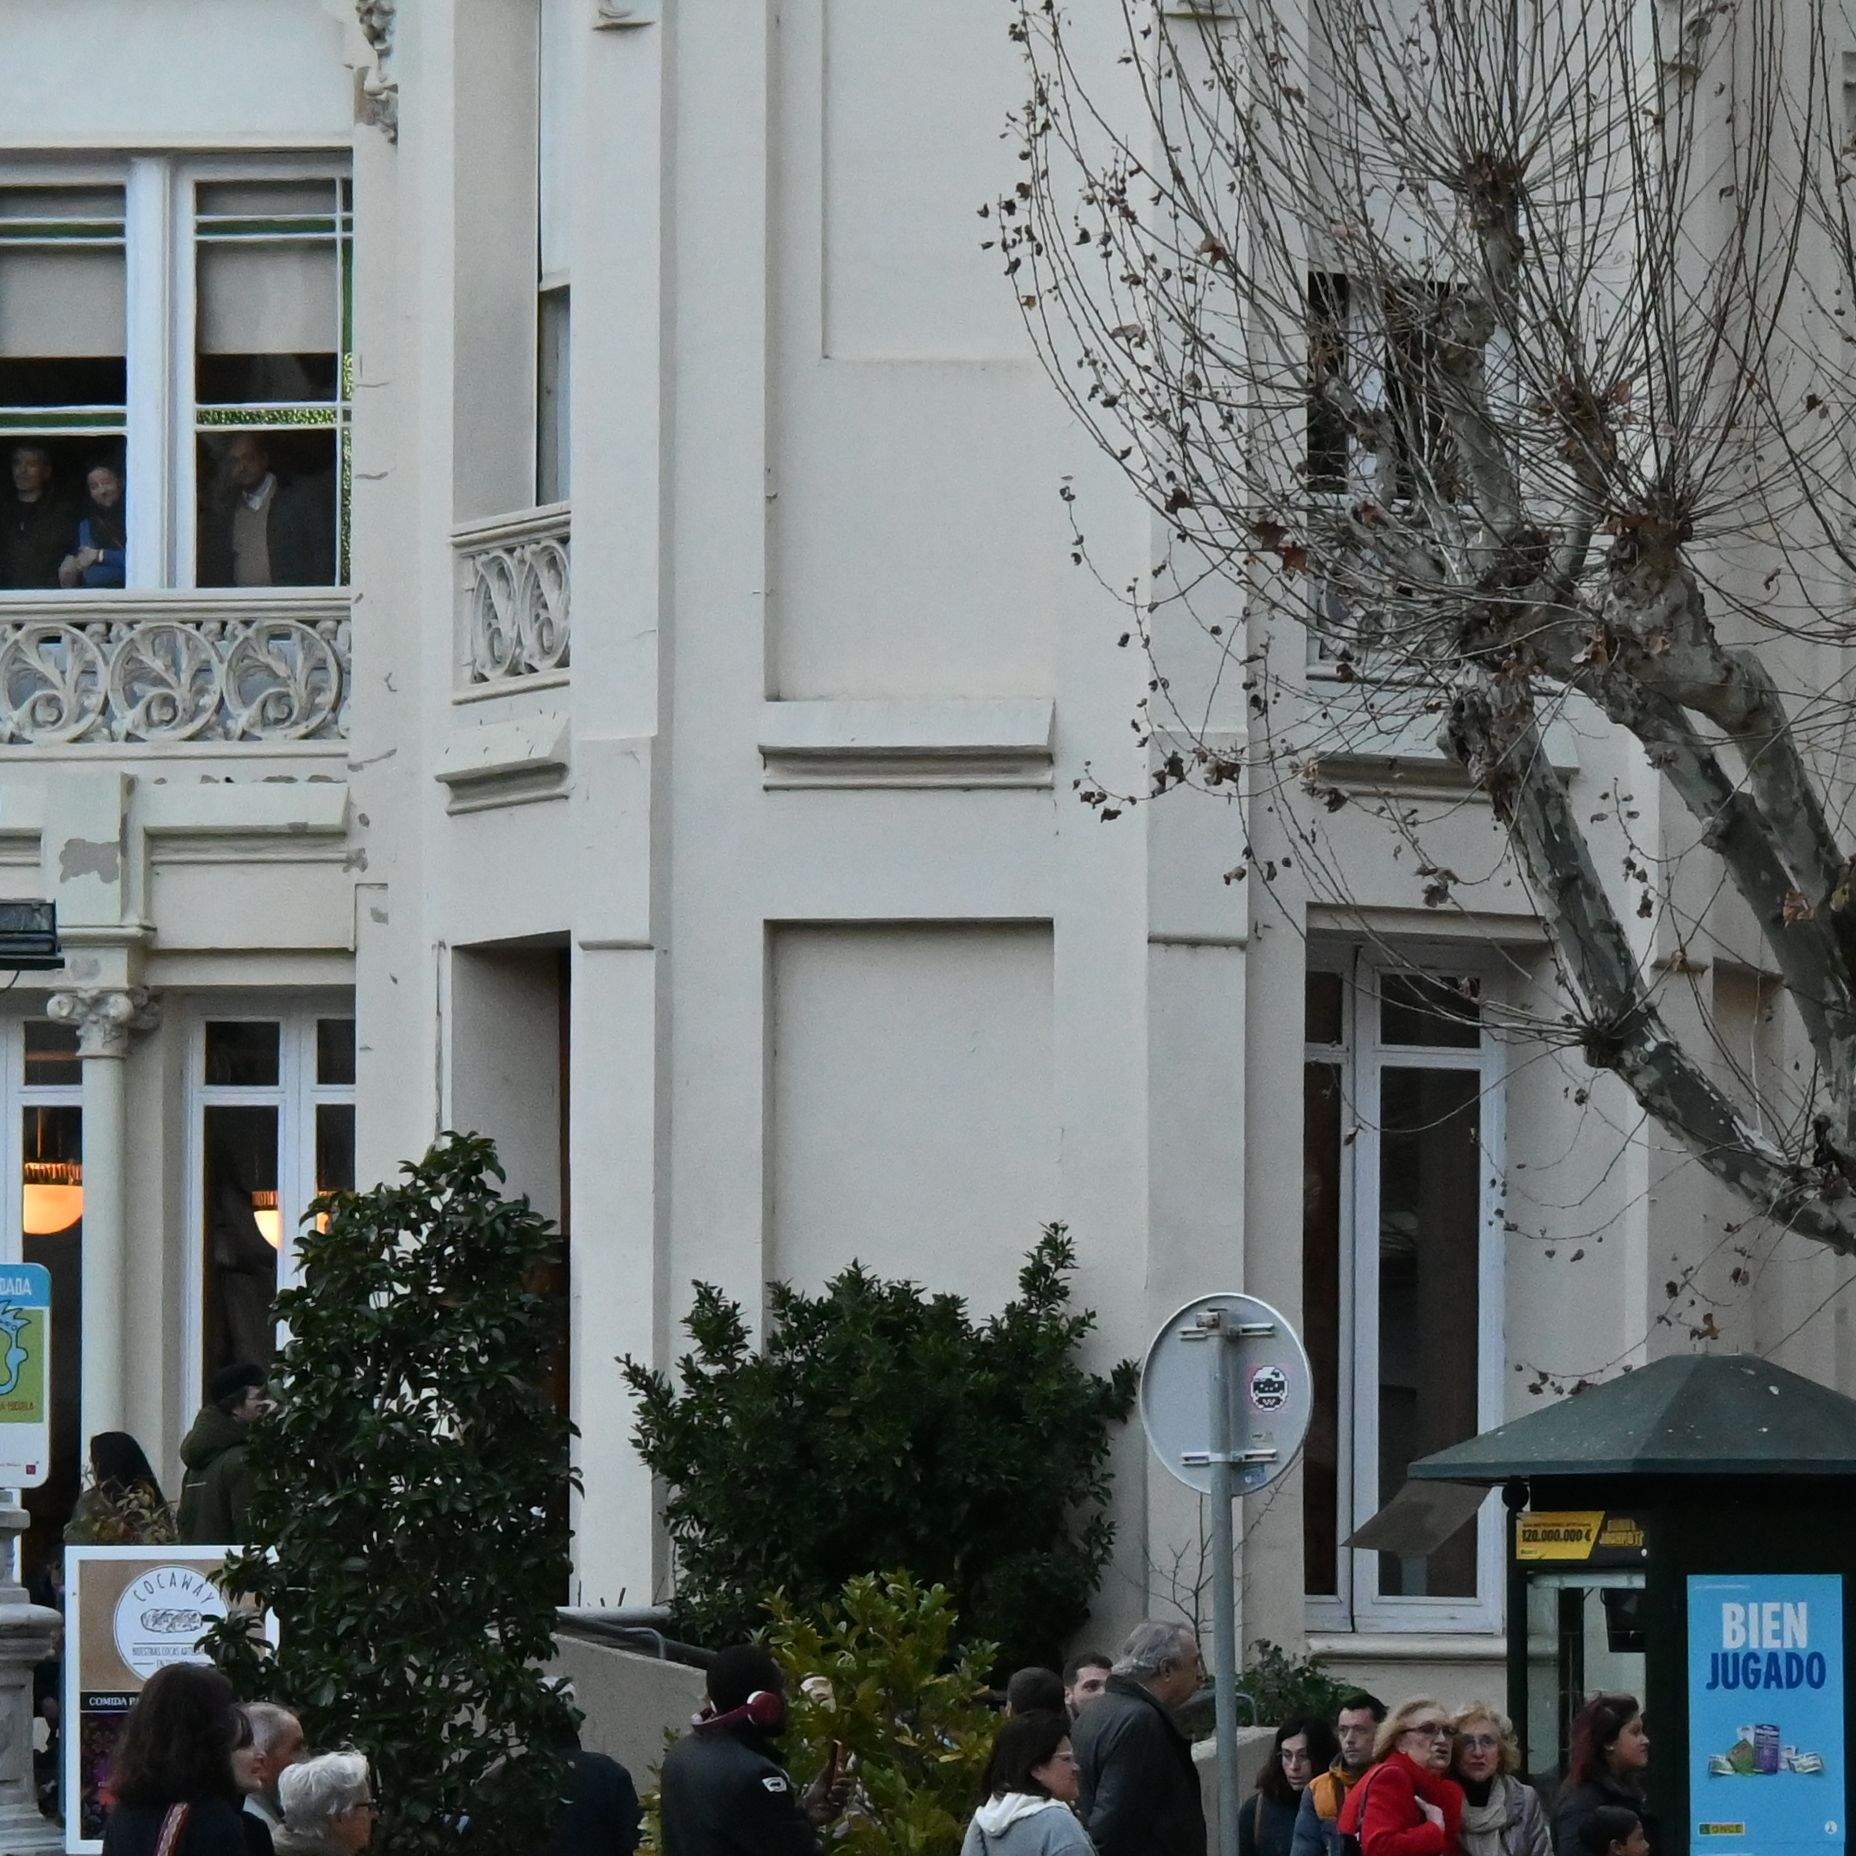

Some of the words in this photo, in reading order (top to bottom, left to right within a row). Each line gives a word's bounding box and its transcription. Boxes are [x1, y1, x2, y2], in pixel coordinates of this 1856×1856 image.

[133, 1572, 214, 1604] COCAWAY
[1722, 1602, 1808, 1649] BIEN
[1706, 1651, 1827, 1690] JUGADO
[89, 1697, 127, 1706] COMIDA
[1711, 1824, 1743, 1834] ONCE
